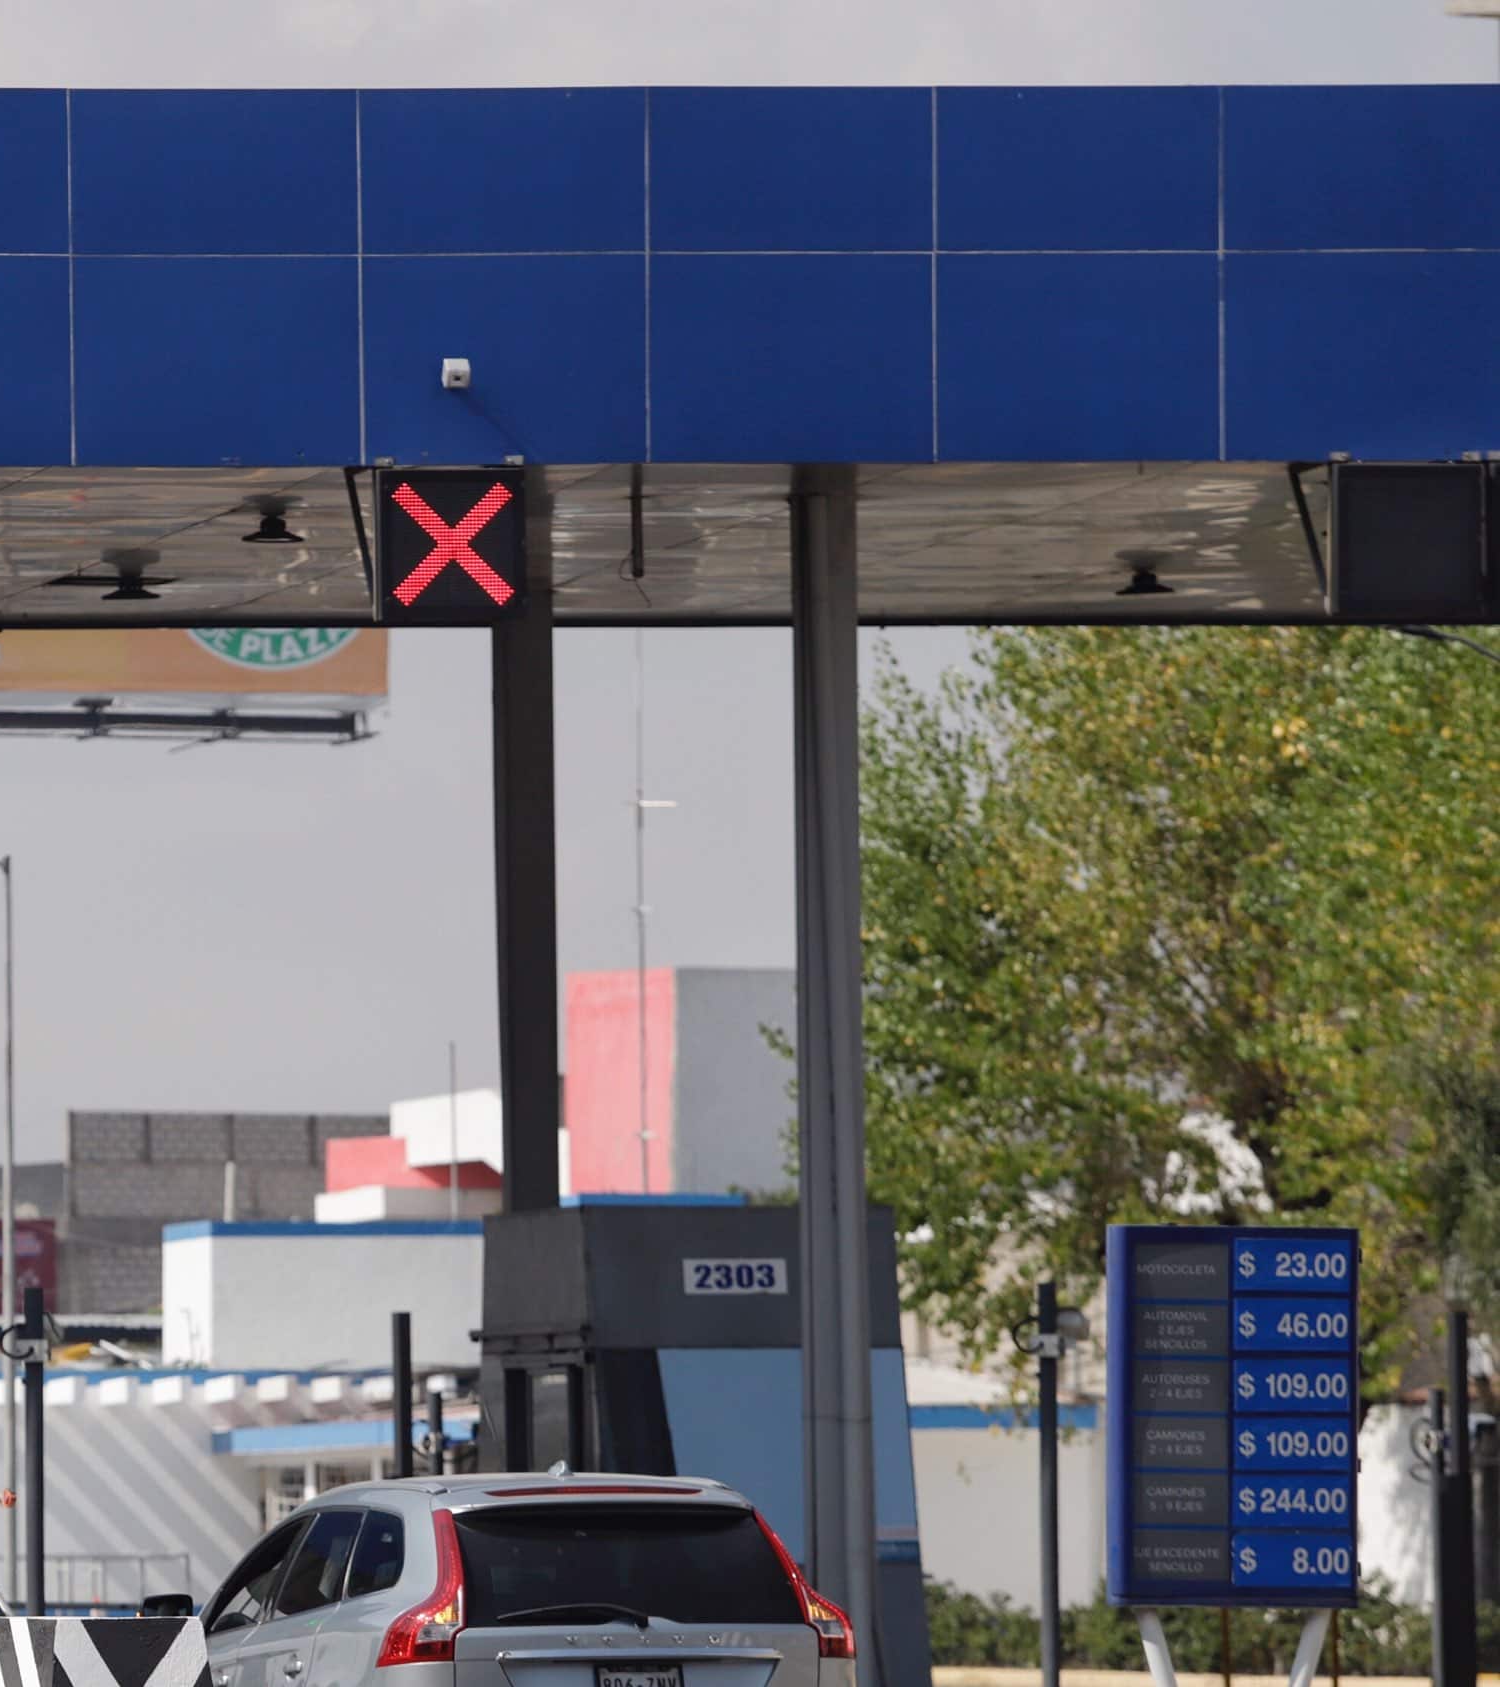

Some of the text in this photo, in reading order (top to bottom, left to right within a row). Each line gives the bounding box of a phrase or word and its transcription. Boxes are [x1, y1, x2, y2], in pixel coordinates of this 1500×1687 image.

[694, 1264, 776, 1289] 2303
[1137, 1263, 1216, 1275] MOTOCICLETA
[1238, 1250, 1347, 1279] $ 23.00
[1238, 1310, 1349, 1339] $ 46.00
[1141, 1373, 1211, 1385] AUTOBUSES
[1237, 1370, 1348, 1400] $ 109.00
[1238, 1429, 1349, 1459] $ 109.00
[1239, 1545, 1350, 1575] $ 8.00
